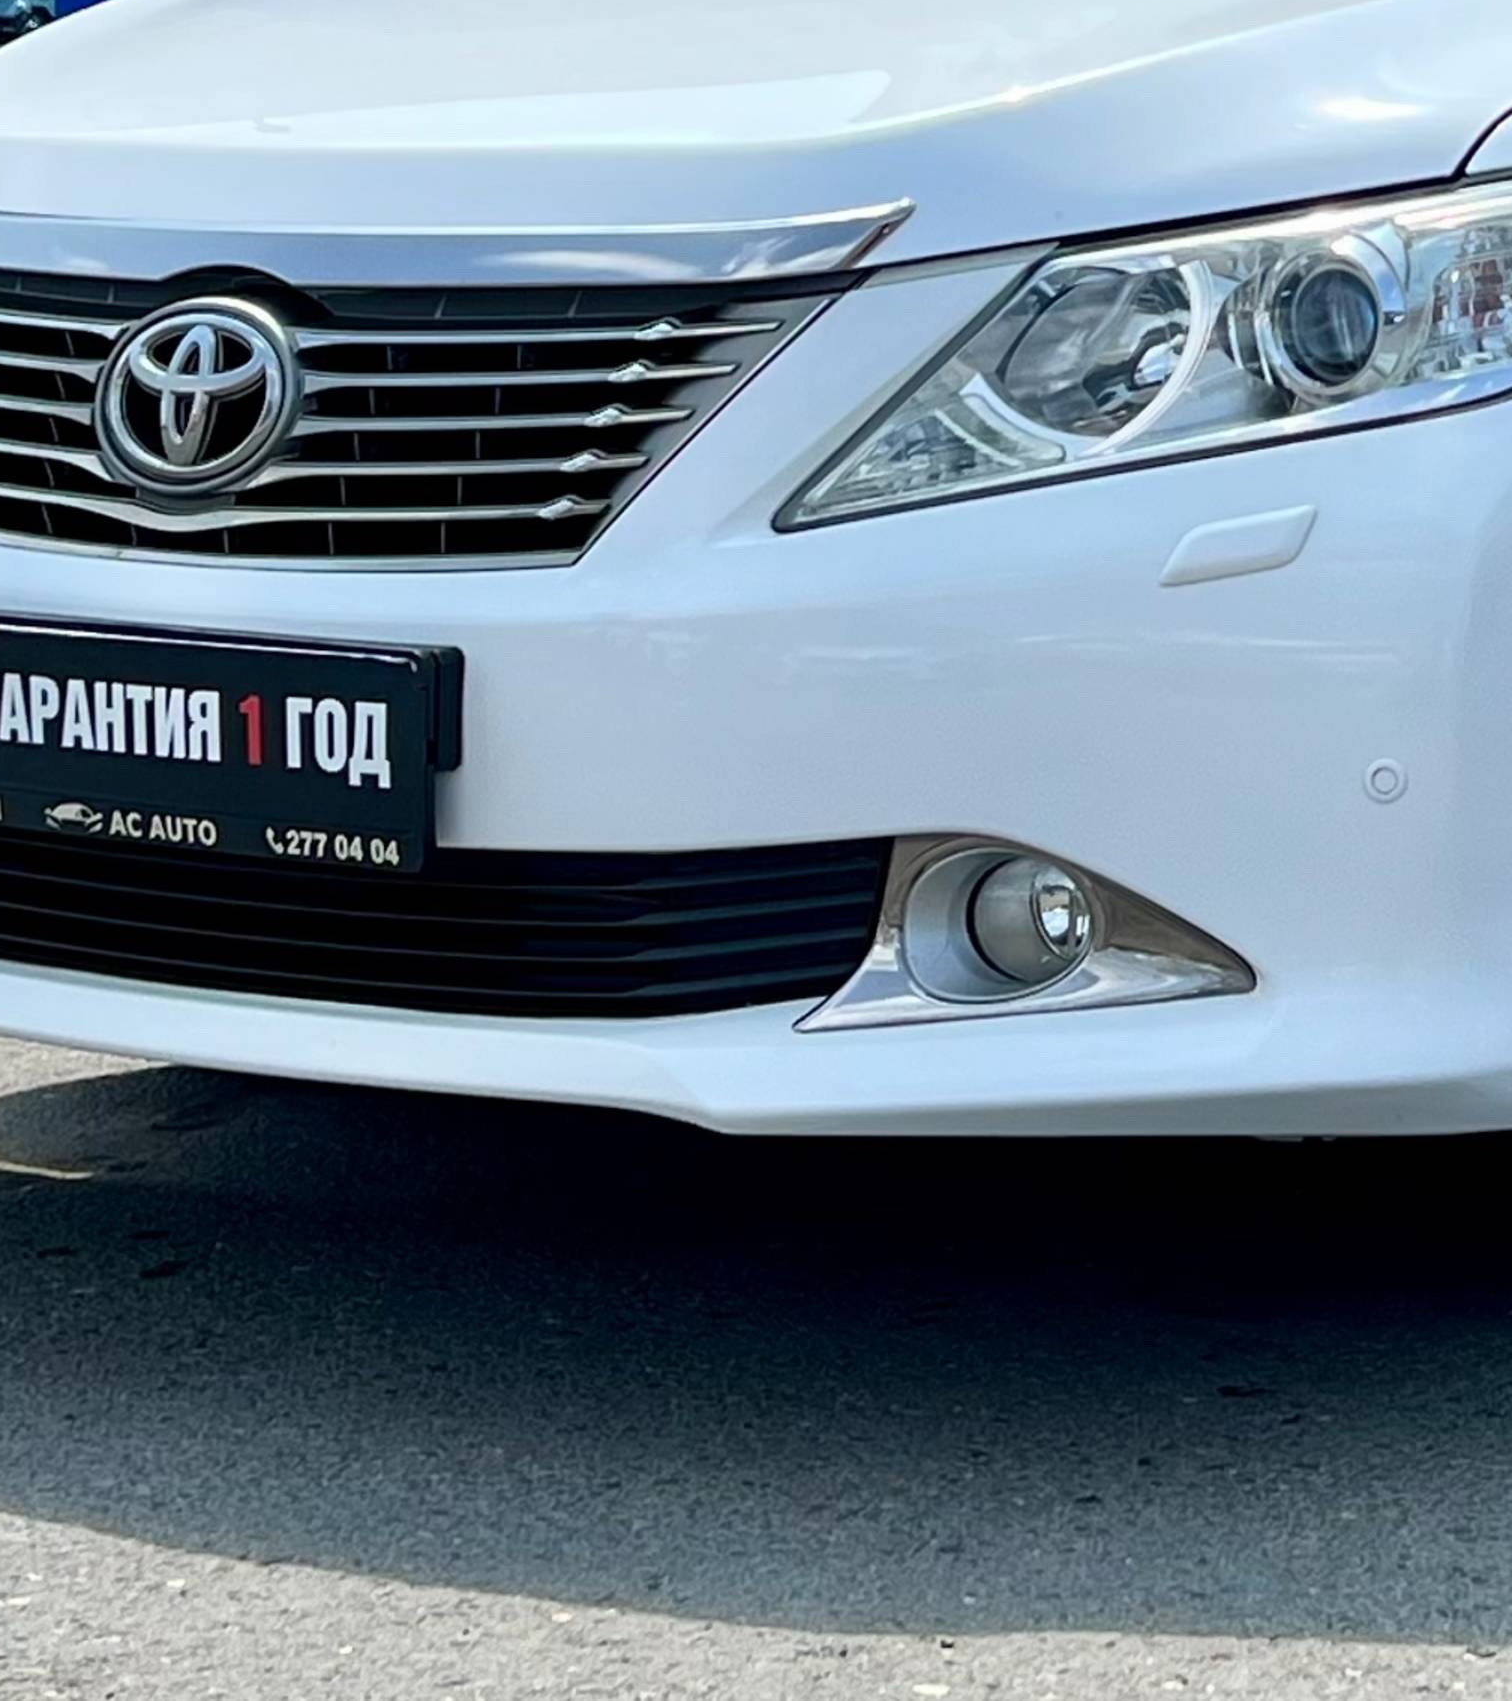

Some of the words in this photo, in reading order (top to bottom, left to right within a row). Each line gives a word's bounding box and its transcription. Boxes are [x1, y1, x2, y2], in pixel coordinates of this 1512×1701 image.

[238, 695, 263, 766] 1
[285, 697, 392, 790] ГОД
[108, 810, 144, 841] AC
[148, 815, 218, 847] AUTO
[285, 830, 325, 860] 277
[333, 836, 364, 863] 04
[370, 838, 400, 866] 04
